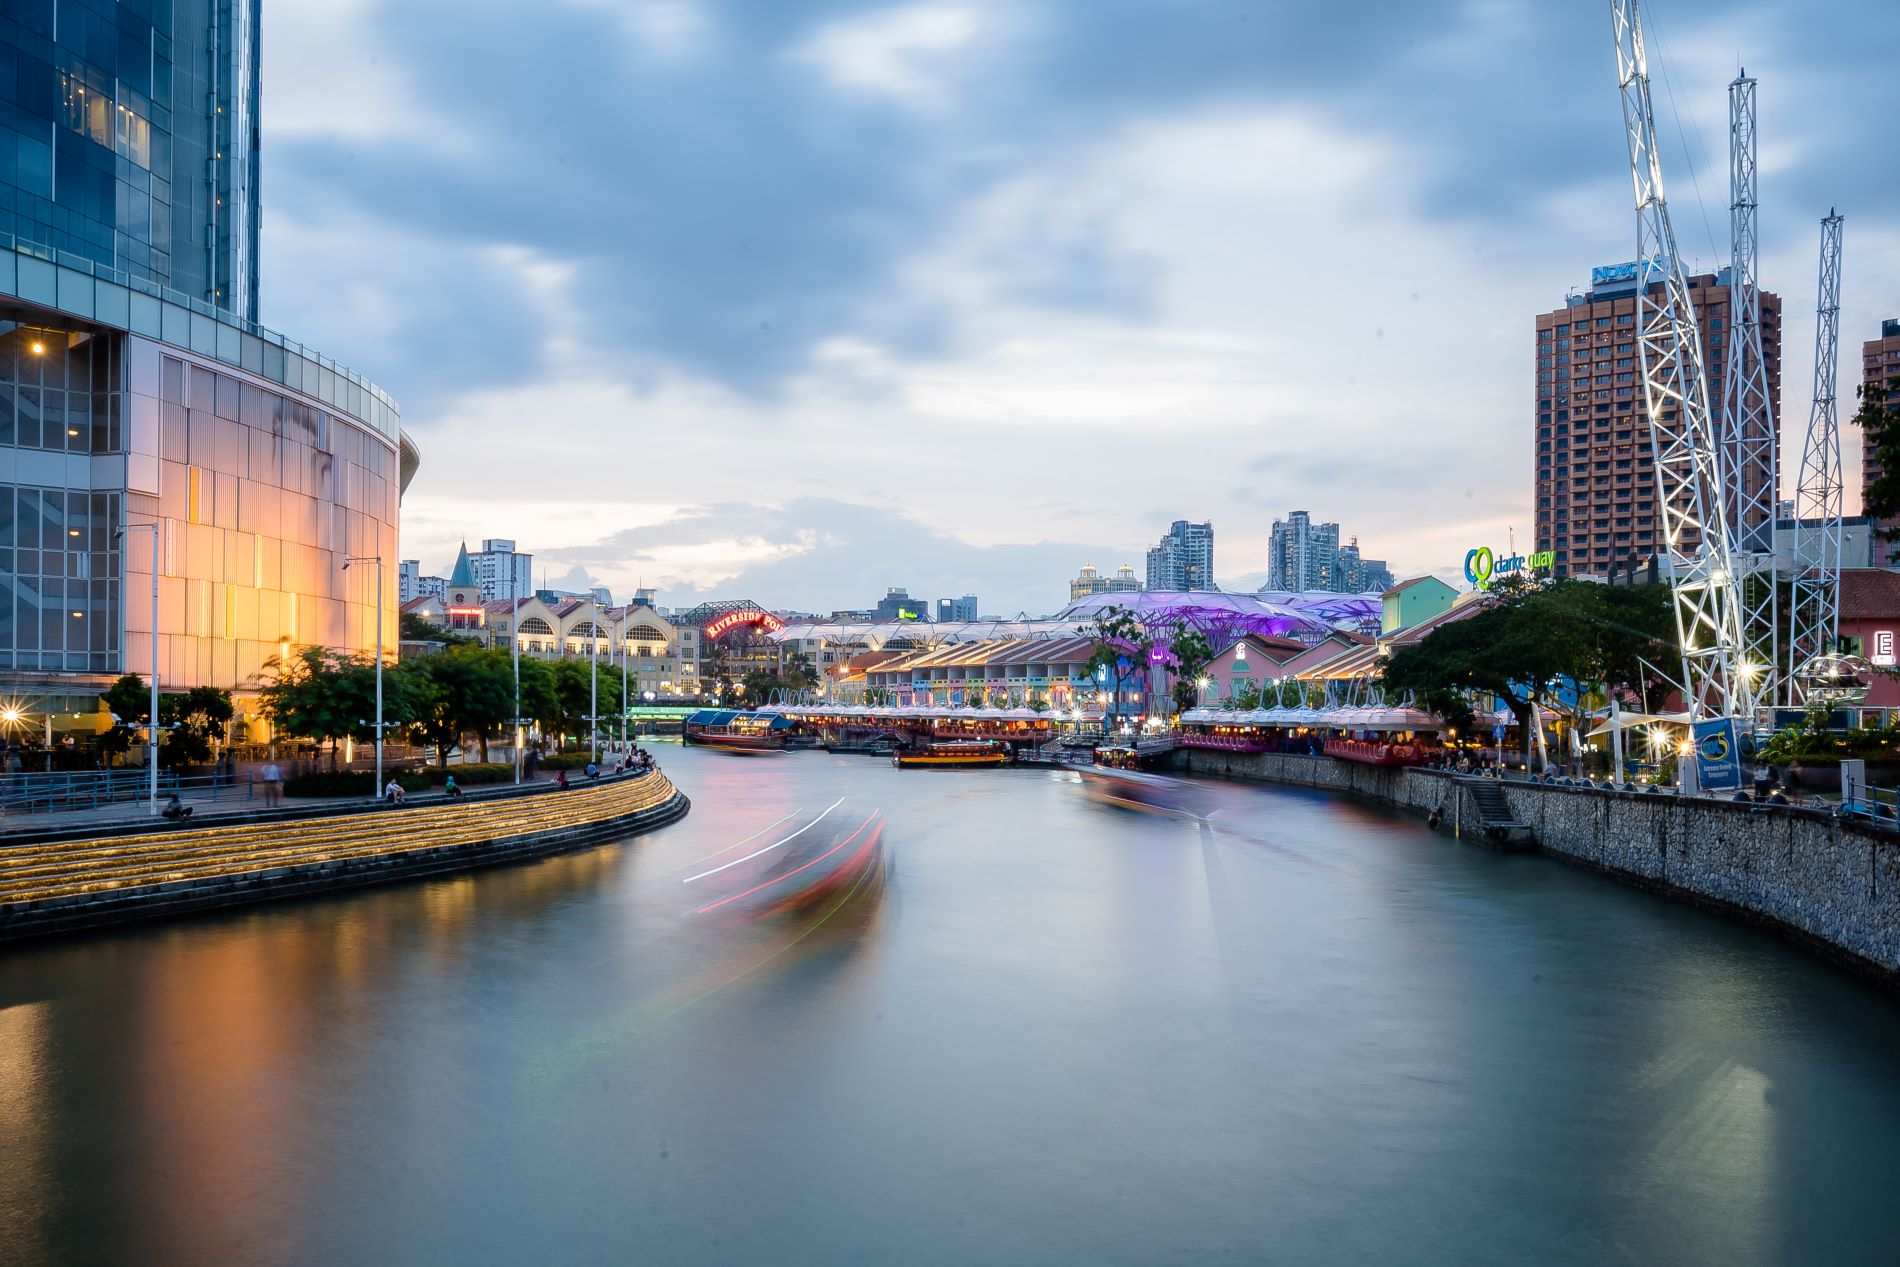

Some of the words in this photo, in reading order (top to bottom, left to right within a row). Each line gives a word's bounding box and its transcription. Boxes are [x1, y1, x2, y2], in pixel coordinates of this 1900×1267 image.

[1493, 552, 1525, 574] clarke
[1528, 550, 1556, 571] quay
[707, 612, 761, 638] RIVERSIDE
